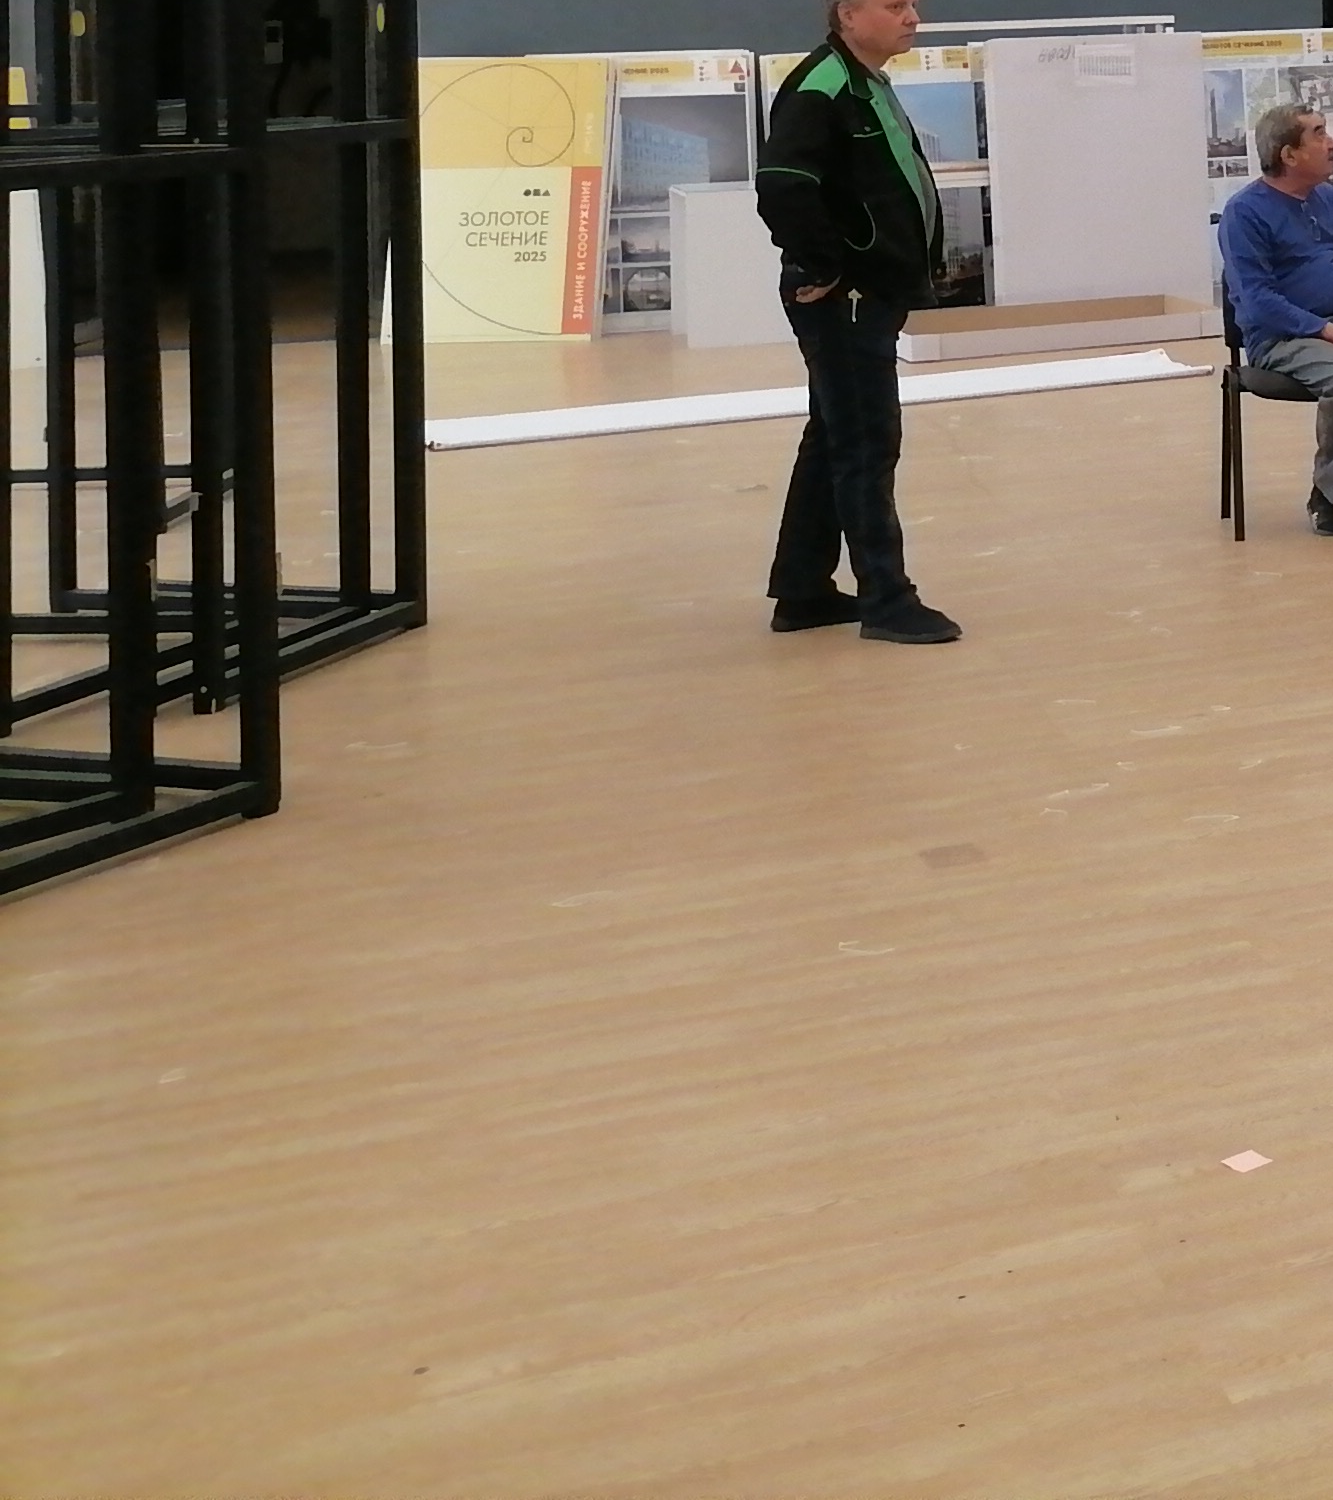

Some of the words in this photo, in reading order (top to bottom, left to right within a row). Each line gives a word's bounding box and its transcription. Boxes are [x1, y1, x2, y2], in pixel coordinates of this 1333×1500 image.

[459, 210, 550, 227] ЗОЛОТОЕ
[577, 180, 593, 260] СООРУЖЕНИЕ
[465, 231, 548, 247] СЕЧЕНИЕ
[513, 251, 547, 263] 2025
[577, 262, 587, 271] И
[572, 274, 587, 321] ЗДАНИЕ
